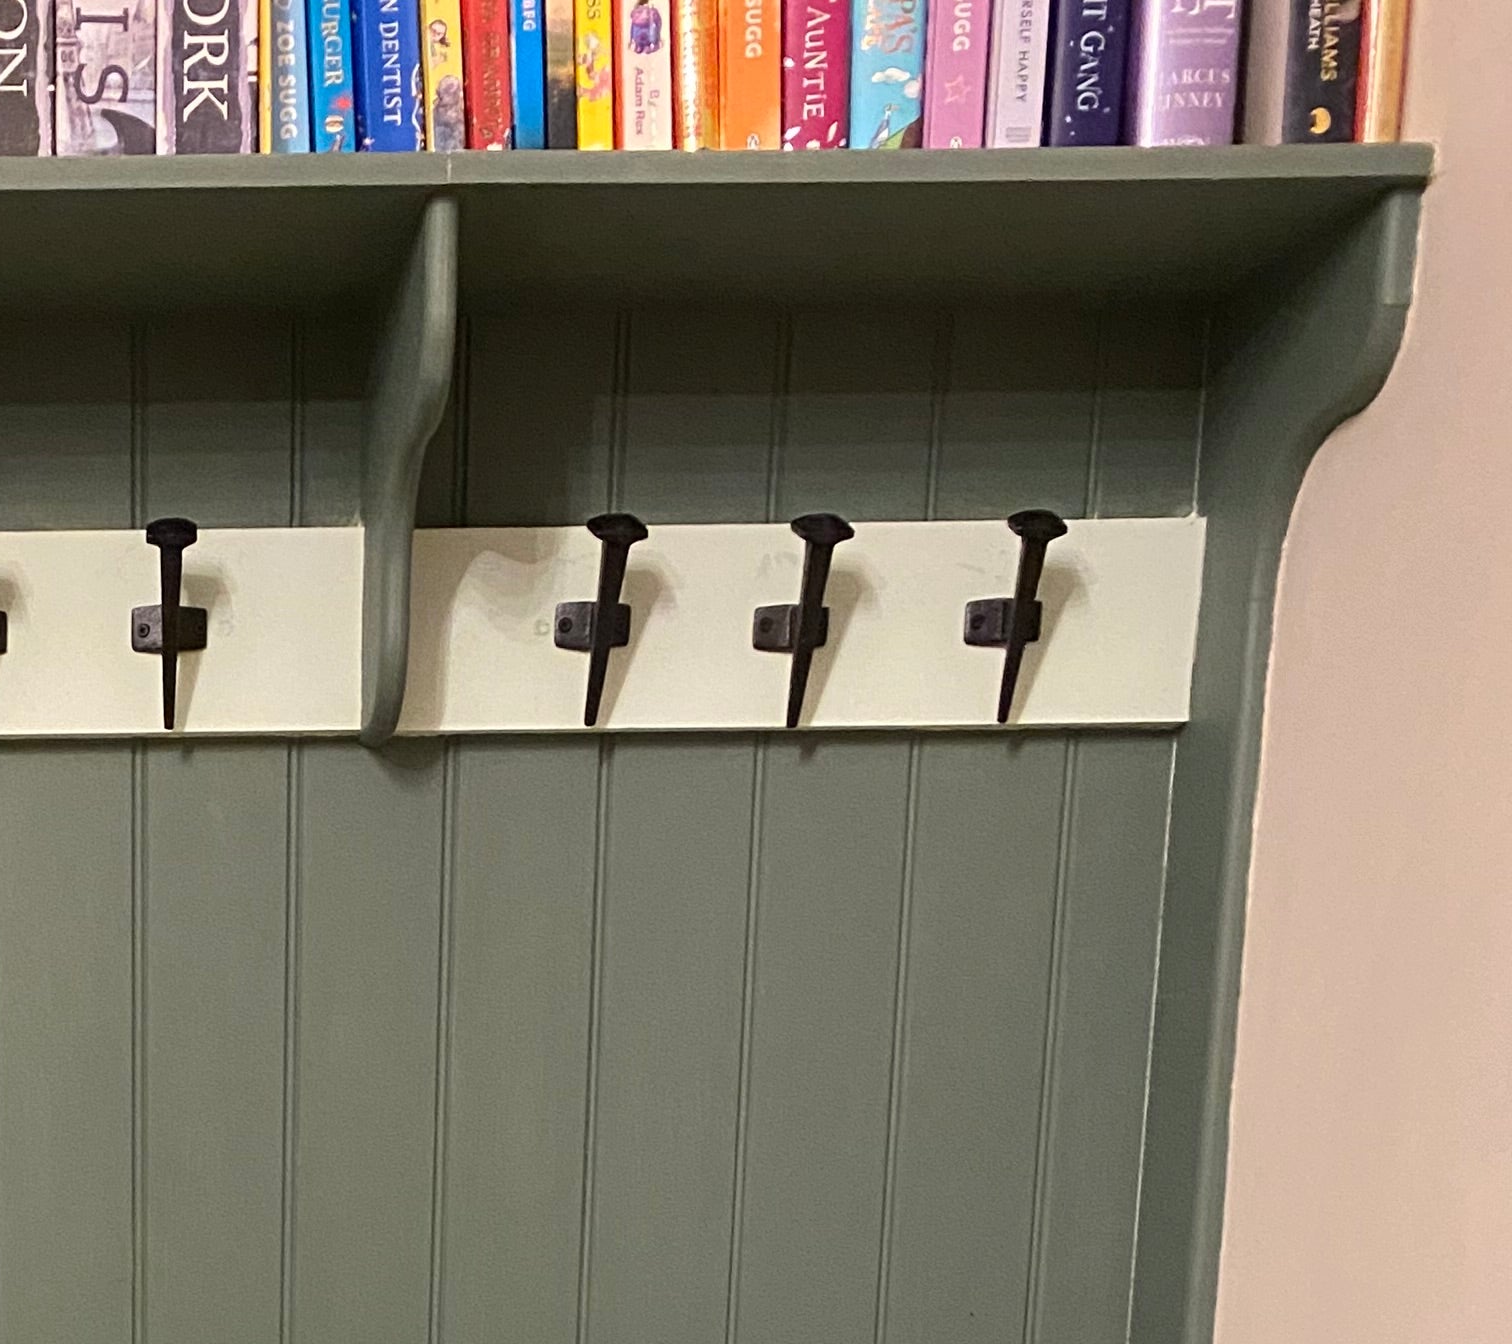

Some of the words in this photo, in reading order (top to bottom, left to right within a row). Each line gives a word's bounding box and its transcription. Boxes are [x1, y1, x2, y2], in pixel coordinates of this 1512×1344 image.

[276, 19, 296, 67] ZOE
[320, 0, 345, 88] URGER
[952, 0, 973, 52] UGG
[378, 21, 403, 127] DENTIST
[1015, 49, 1033, 104] HAPPY
[1075, 30, 1106, 112] GANG
[278, 74, 299, 141] SUGG
